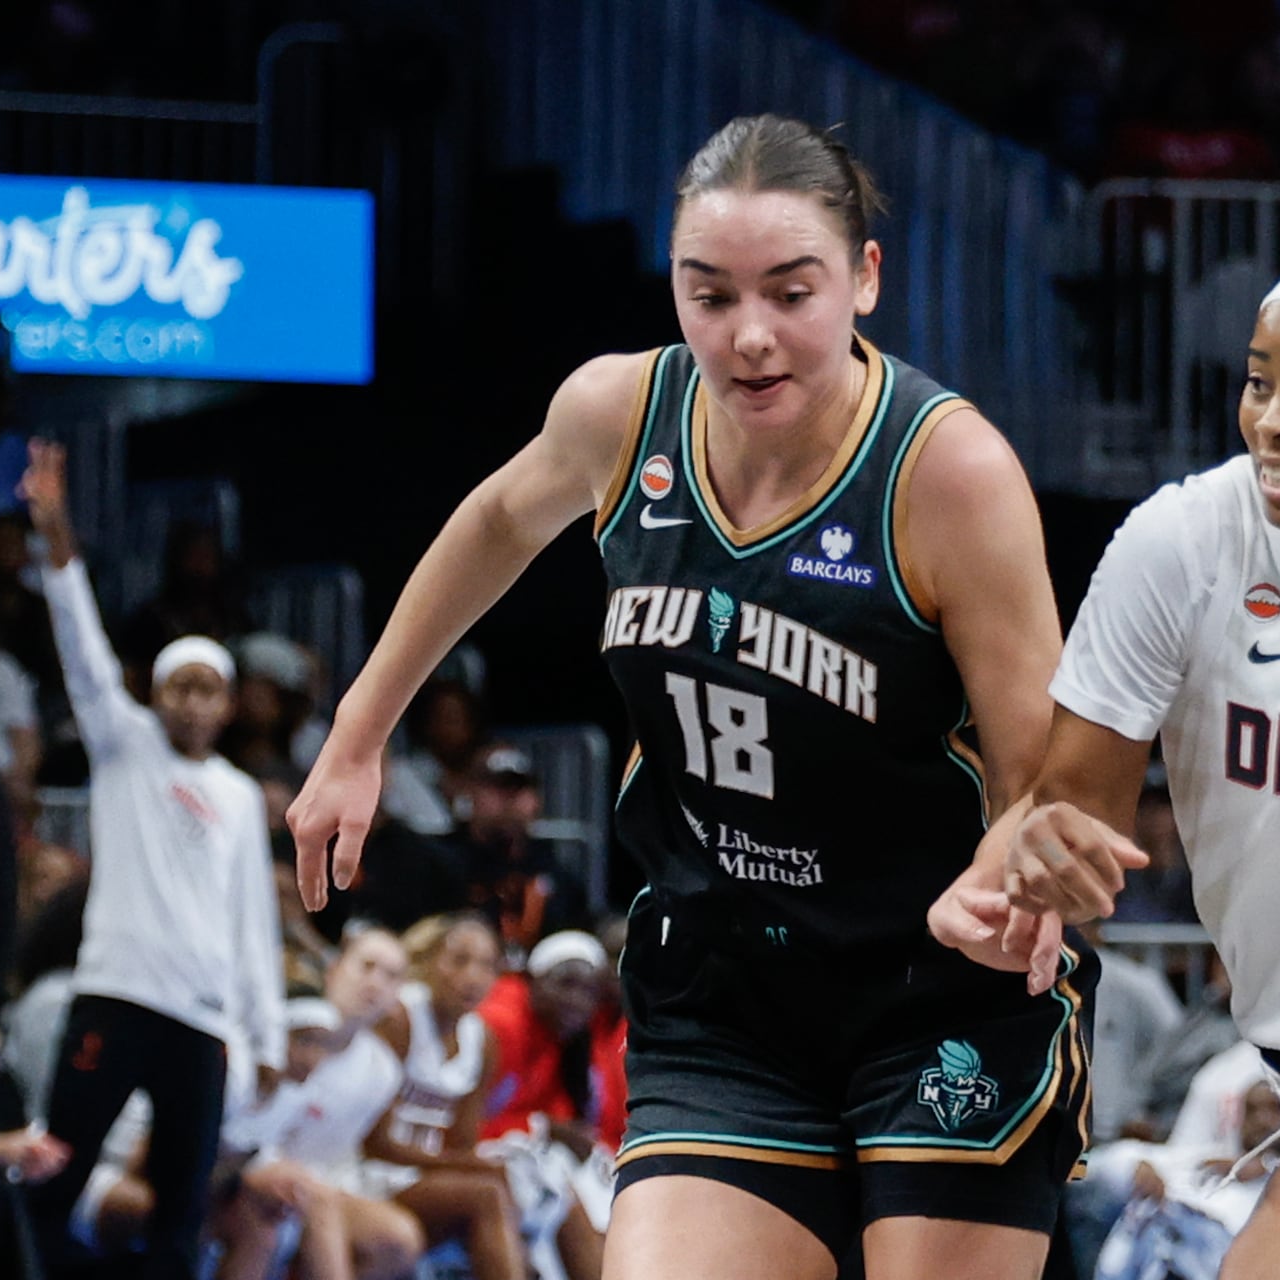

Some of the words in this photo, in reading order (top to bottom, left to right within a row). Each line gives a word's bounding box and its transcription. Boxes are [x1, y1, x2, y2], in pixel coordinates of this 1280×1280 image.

[790, 556, 873, 585] BARCLAYS
[602, 585, 703, 653] NEW
[738, 598, 878, 724] YORK
[665, 671, 774, 801] 18
[717, 823, 819, 872] Liberty
[718, 852, 823, 887] Mutual
